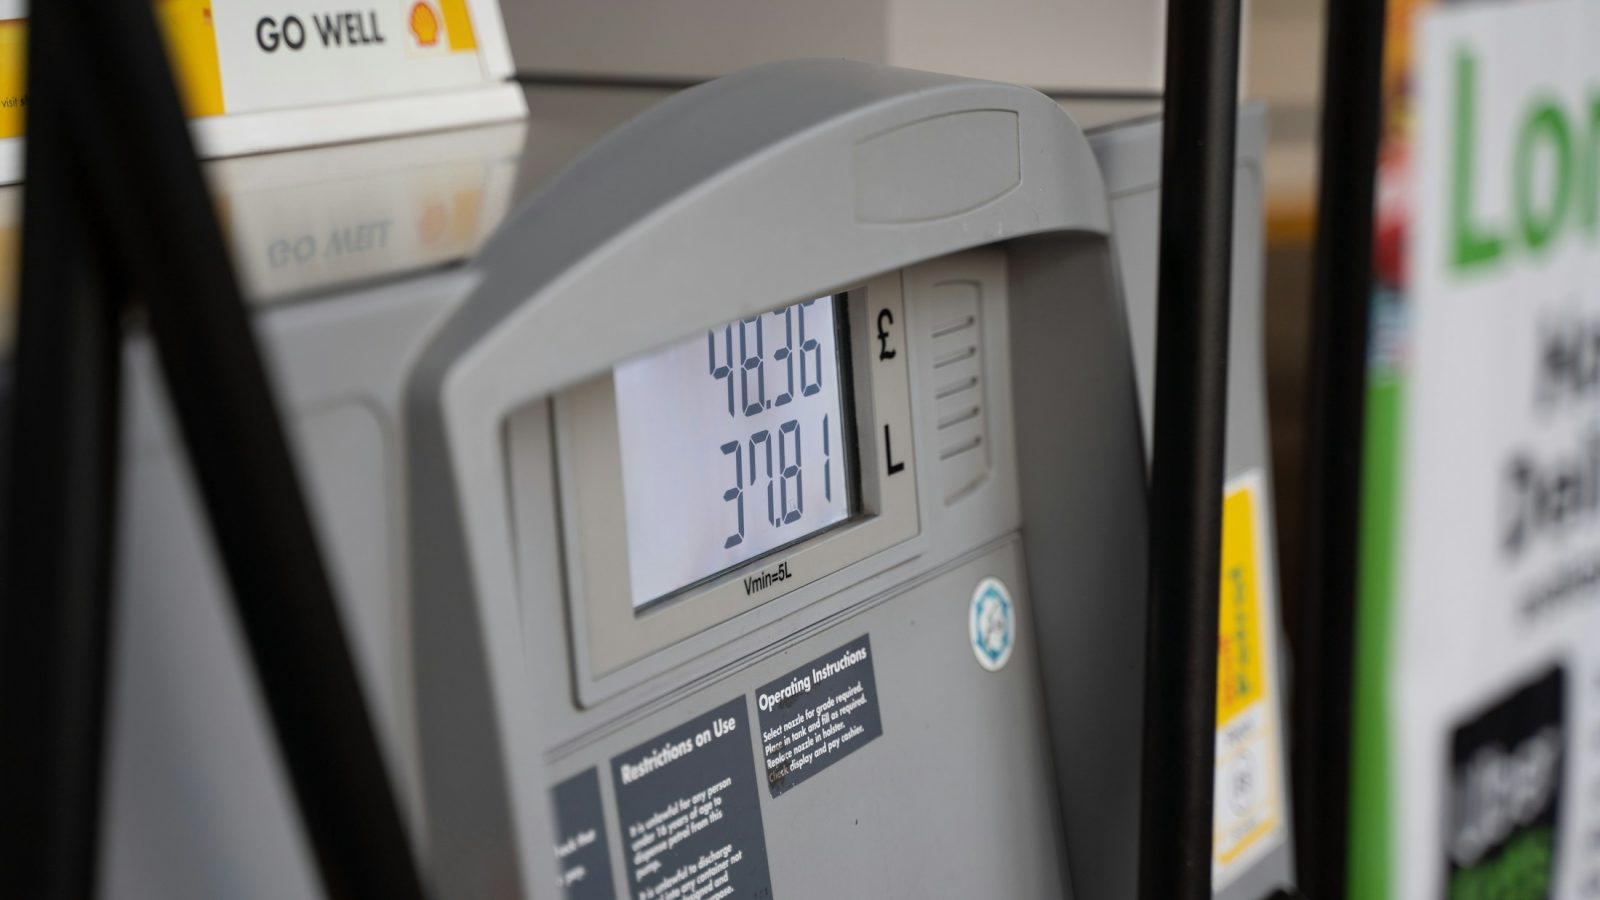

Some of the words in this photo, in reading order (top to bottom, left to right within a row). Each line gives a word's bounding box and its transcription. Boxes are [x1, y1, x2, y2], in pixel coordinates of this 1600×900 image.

[256, 15, 306, 53] GO
[312, 9, 386, 48] WELL
[877, 309, 896, 361] £
[708, 299, 822, 418] 48.36
[884, 424, 905, 476] L
[719, 413, 831, 549] 37.81
[744, 561, 792, 596] Vmin=5L
[758, 677, 811, 711] Operating
[812, 647, 867, 683] Instructions
[763, 723, 783, 743] Select
[783, 714, 804, 732] nozzle
[804, 706, 815, 720] for
[816, 697, 835, 717] grade
[835, 681, 863, 704] required.
[765, 740, 783, 756] Place
[783, 735, 791, 746] in
[791, 728, 807, 743] tank
[808, 718, 820, 732] and
[821, 711, 830, 726] fill
[831, 710, 838, 720] as
[620, 738, 693, 785] Restrictions
[695, 729, 712, 748] on
[713, 717, 736, 738] Use
[767, 750, 792, 769] Replace
[793, 736, 814, 754] nozzle
[815, 732, 822, 743] in
[822, 721, 846, 738] holster.
[790, 752, 813, 772] display
[814, 742, 827, 757] and
[828, 738, 840, 753] pay
[667, 814, 689, 835] years
[689, 807, 698, 820] of
[698, 802, 713, 817] age
[713, 796, 722, 806] to
[679, 796, 690, 811] for
[691, 790, 706, 805] any
[707, 776, 732, 799] person
[691, 818, 709, 835] from
[709, 809, 723, 823] this
[680, 879, 696, 894] any
[696, 859, 729, 884] container
[730, 850, 742, 864] not
[688, 863, 697, 875] to
[698, 843, 732, 870] discharge
[714, 869, 729, 888] and
